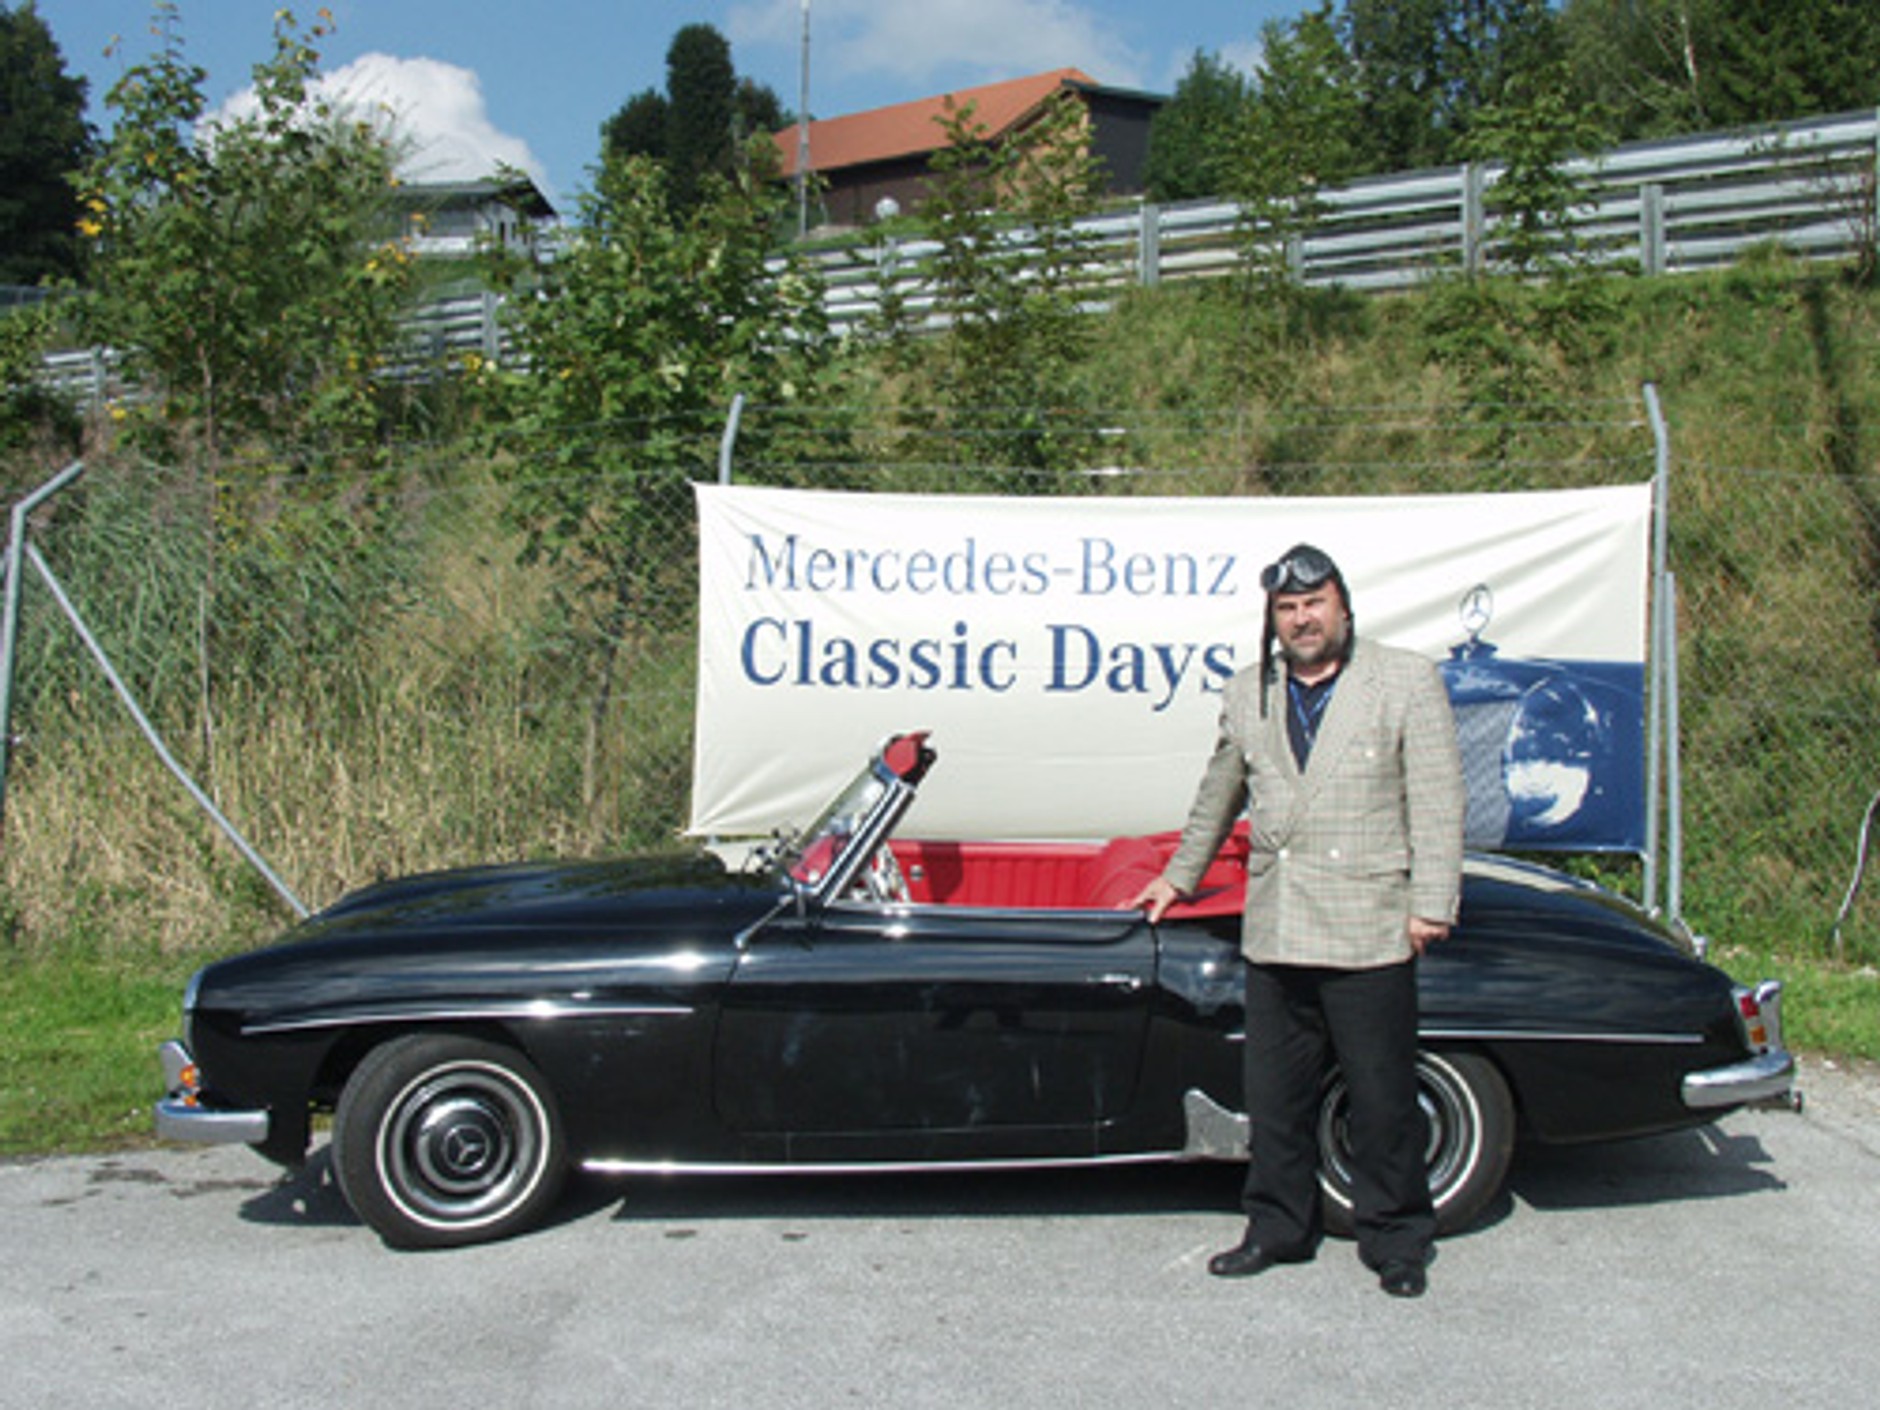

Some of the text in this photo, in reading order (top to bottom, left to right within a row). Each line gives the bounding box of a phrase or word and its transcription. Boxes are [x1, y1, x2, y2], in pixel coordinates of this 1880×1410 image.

[744, 533, 1238, 596] Mercedes-Benz
[740, 616, 1236, 712] Classic Days
